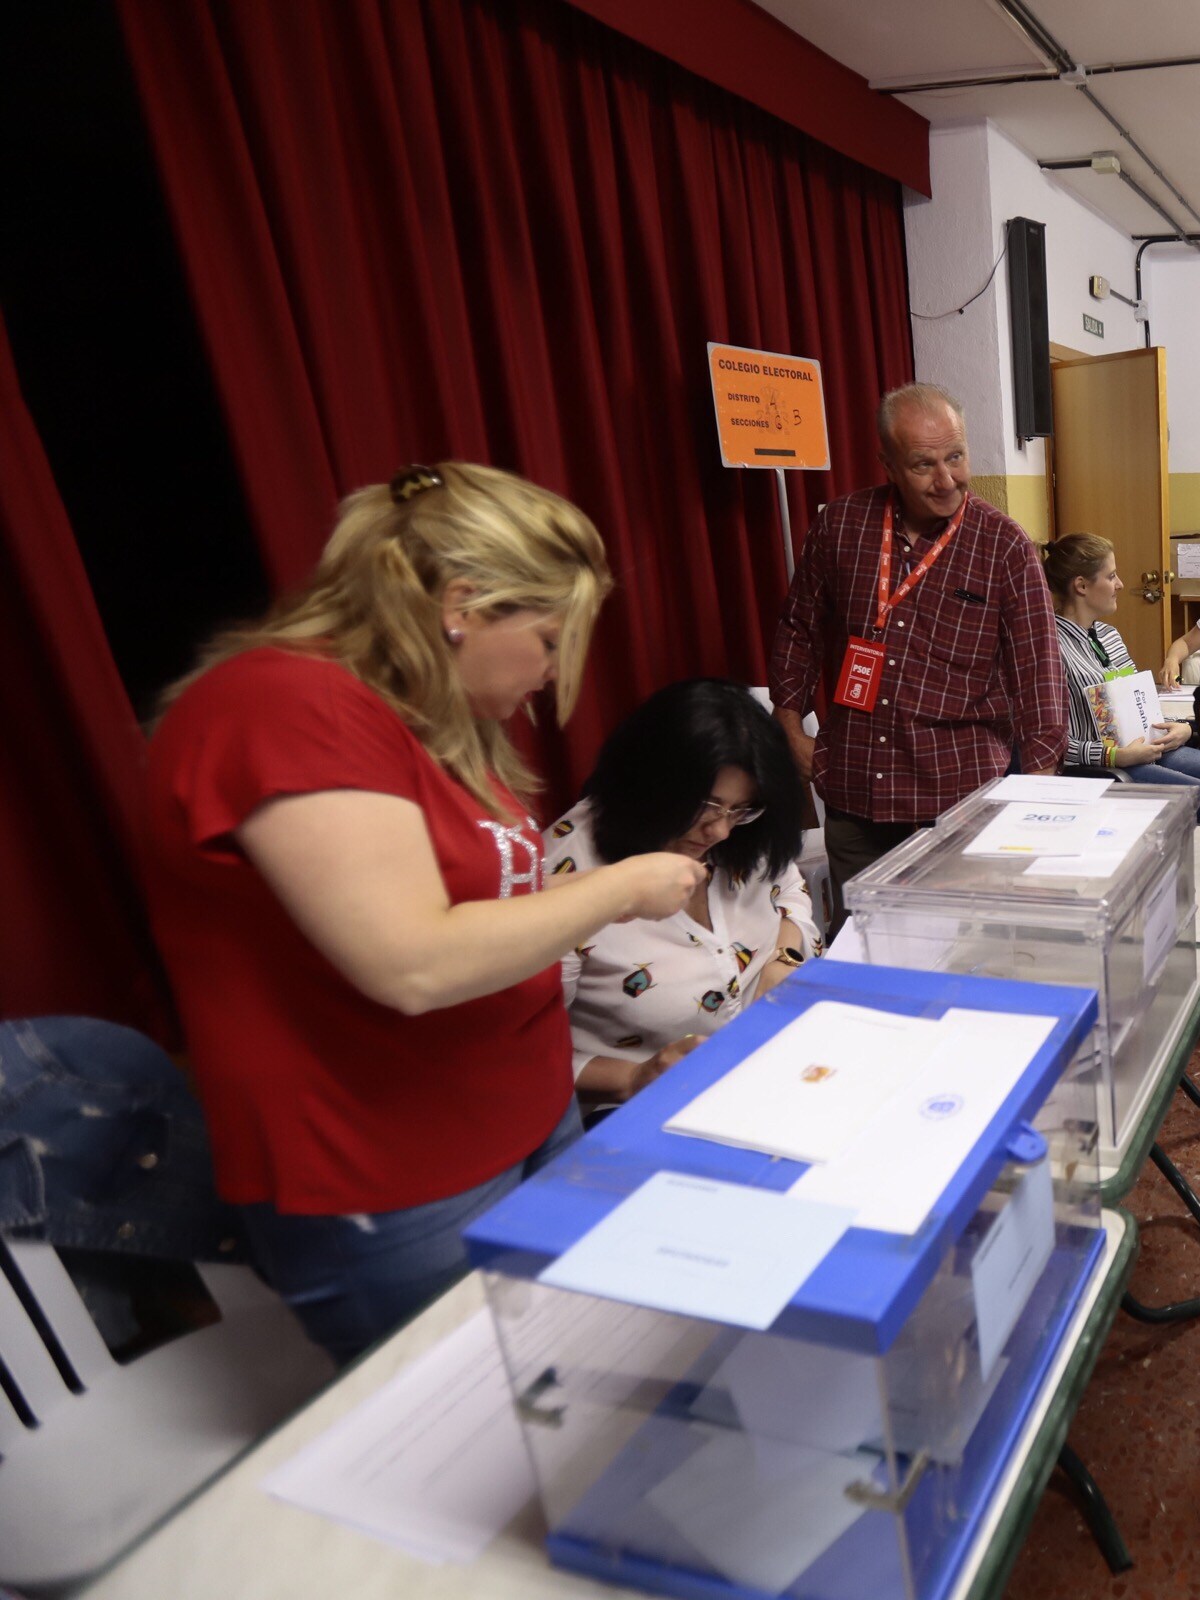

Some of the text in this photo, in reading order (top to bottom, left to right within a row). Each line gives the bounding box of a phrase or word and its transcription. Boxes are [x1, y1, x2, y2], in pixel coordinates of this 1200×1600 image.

[718, 359, 813, 381] COLEGIO ELECTORAL
[728, 392, 760, 403] DISTRITO
[730, 417, 770, 429] SECCIONES
[853, 664, 872, 676] PSOE
